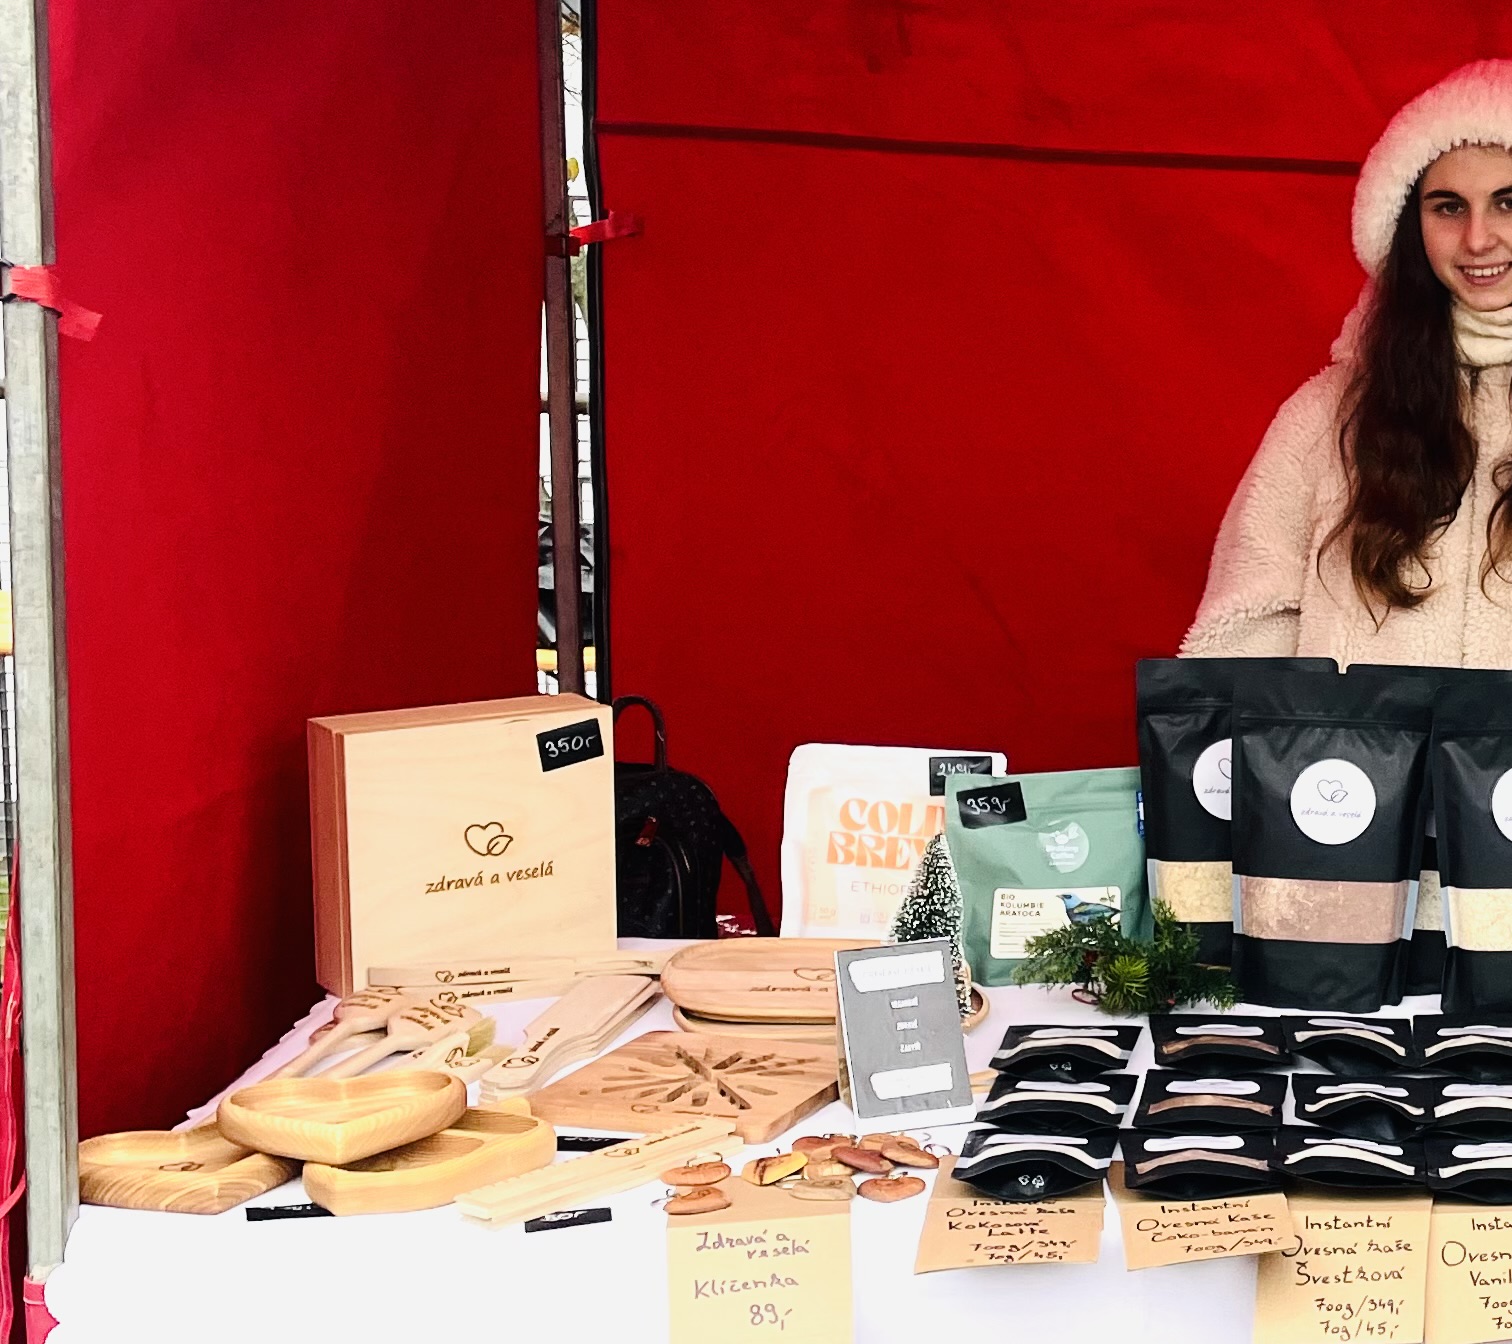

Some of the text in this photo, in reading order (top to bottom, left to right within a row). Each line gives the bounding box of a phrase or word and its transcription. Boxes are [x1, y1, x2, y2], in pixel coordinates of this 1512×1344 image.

[425, 860, 554, 894] zdravá a veselá
[1161, 1200, 1251, 1214] Instantní
[1136, 1217, 1220, 1232] Ovesná
[1305, 1215, 1393, 1231] Instantní
[695, 1229, 791, 1253] Zdravá a
[747, 1239, 810, 1260] veselá
[694, 1273, 799, 1299] Klíčenka
